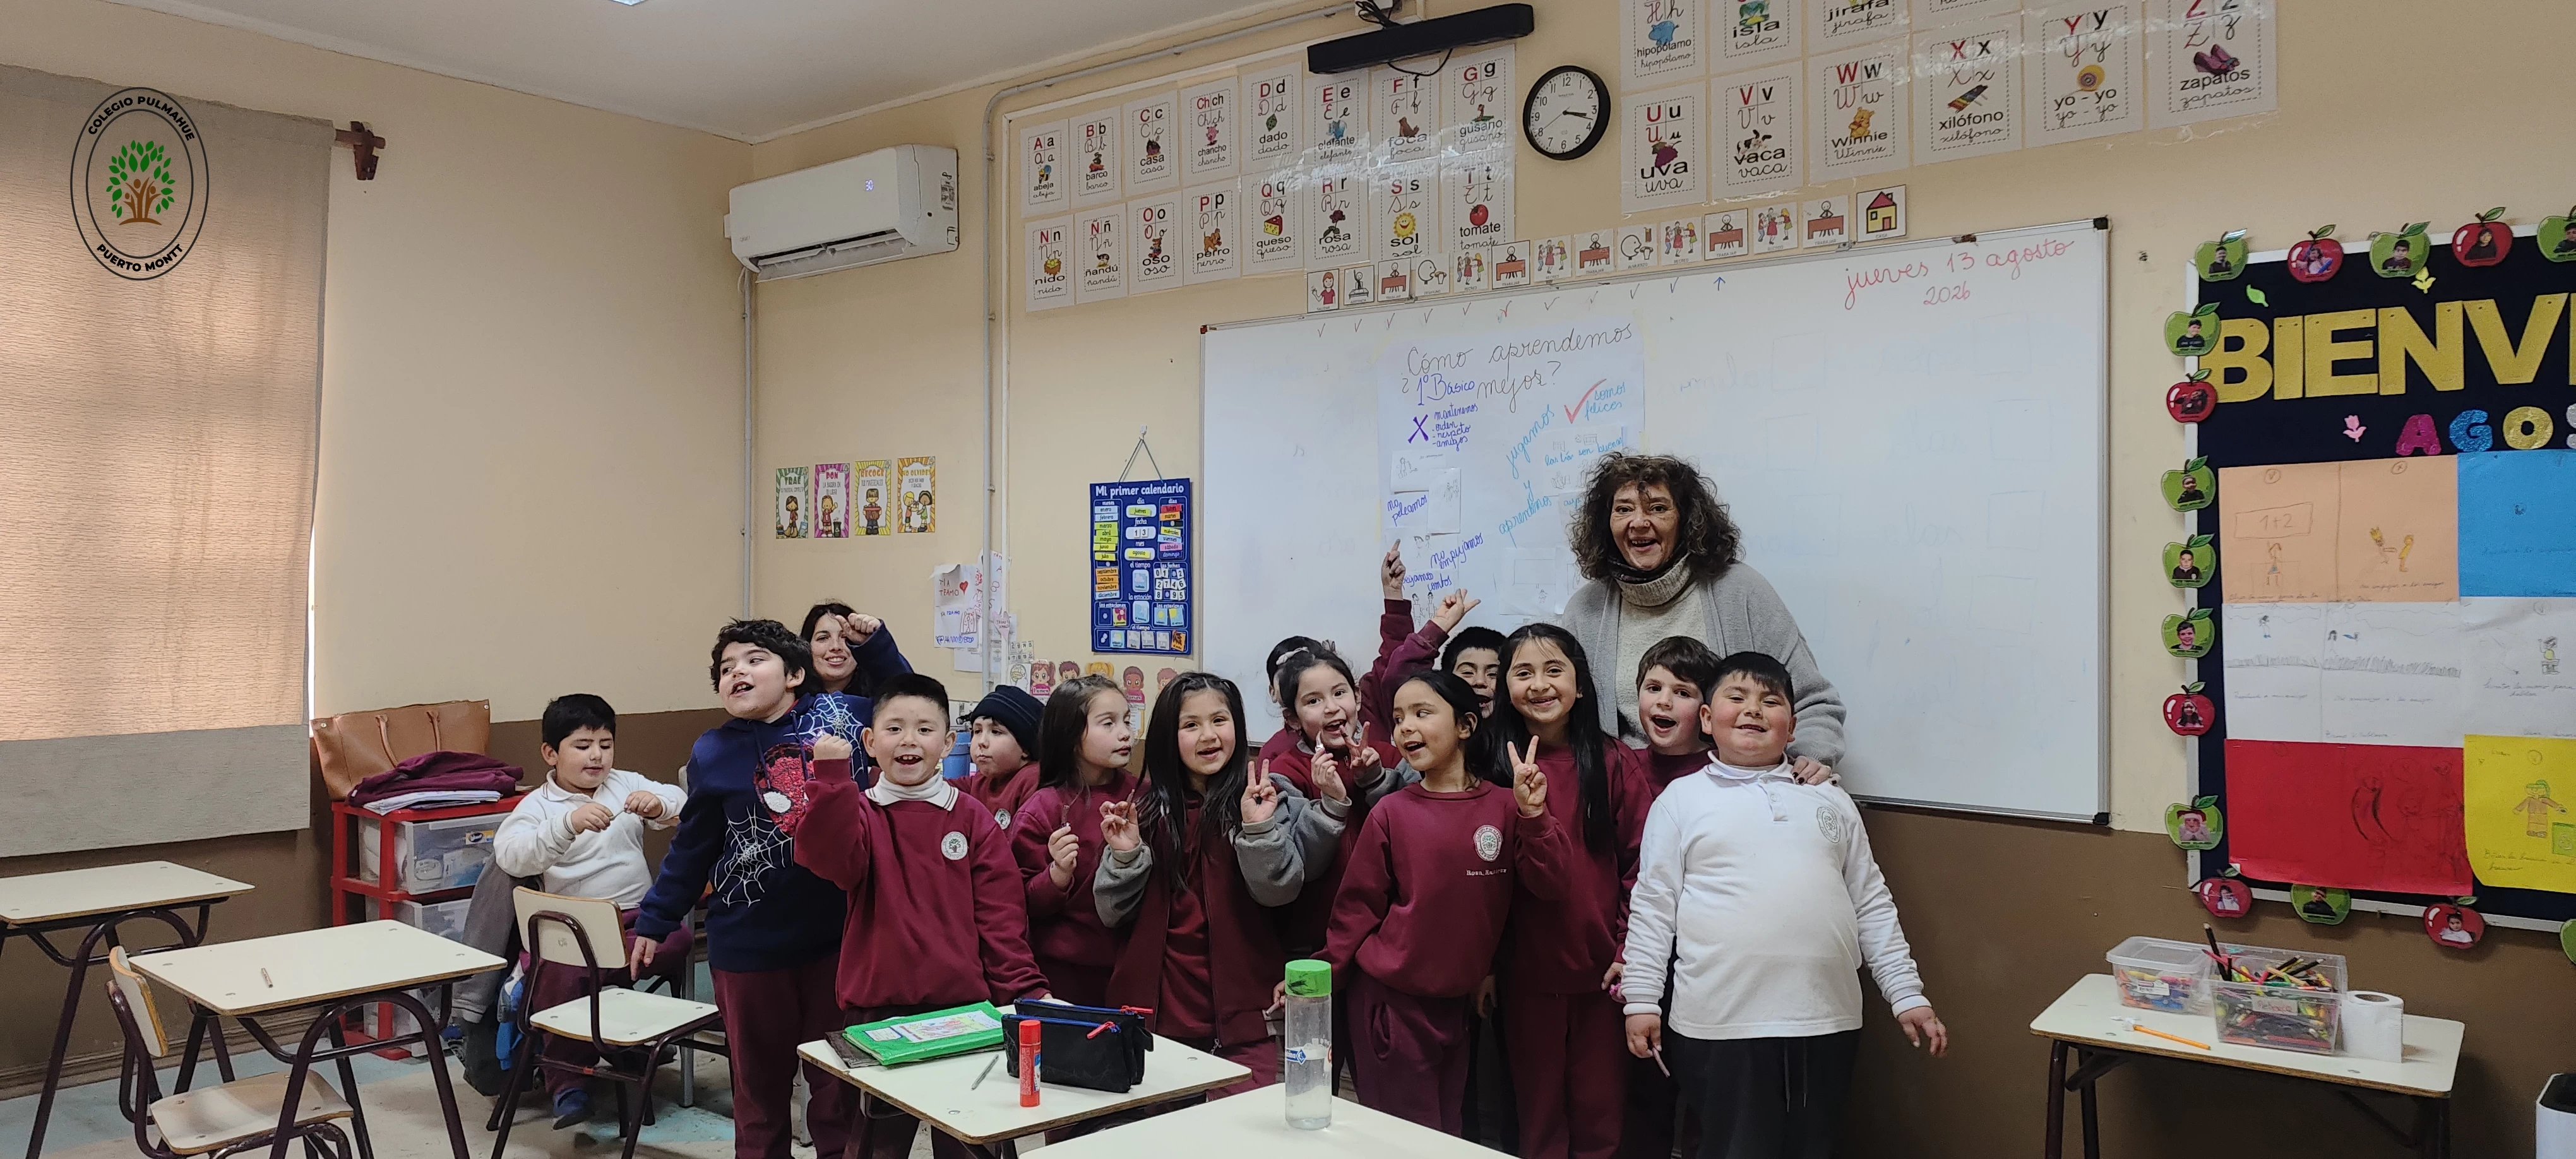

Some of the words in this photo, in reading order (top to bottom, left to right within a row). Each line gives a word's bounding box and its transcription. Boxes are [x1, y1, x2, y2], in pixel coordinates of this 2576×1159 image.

[1733, 20, 1780, 38] isla
[2065, 16, 2082, 36] Y
[2094, 10, 2109, 30] y
[1637, 39, 1691, 57] hipopótamo
[1951, 40, 1966, 61] X
[1977, 40, 1991, 56] x
[1464, 67, 1477, 81] G
[1484, 61, 1496, 77] g
[1837, 61, 1858, 84] W
[1864, 62, 1882, 79] w
[1393, 79, 1404, 93] F
[1414, 75, 1420, 88] f
[1562, 76, 1571, 86] 12
[1579, 80, 1582, 89] 1
[2179, 69, 2250, 91] zapatos
[1260, 83, 1271, 98] D
[1277, 79, 1285, 93] d
[1323, 87, 1333, 103] E
[1340, 86, 1351, 98] e
[1551, 83, 1556, 93] 11
[1587, 89, 1594, 99] 2
[1739, 85, 1753, 106] V
[1762, 86, 1773, 101] v
[1197, 98, 1210, 109] Ch
[1212, 94, 1224, 106] ch
[1539, 96, 1547, 106] 10
[2053, 94, 2076, 111] yo
[2094, 87, 2116, 107] yo
[1140, 109, 1150, 122] C
[1155, 109, 1163, 119] c
[1534, 112, 1540, 121] 9
[1592, 105, 1597, 114] 3
[1647, 105, 1662, 122] U
[1669, 104, 1681, 118] u
[1460, 119, 1503, 136] gusano
[1586, 122, 1591, 131] 4
[1939, 109, 2004, 132] xilófono
[1086, 126, 1094, 137] B
[1098, 122, 1106, 134] b
[1537, 128, 1544, 136] 8
[1034, 138, 1043, 150] A
[1047, 138, 1054, 147] a
[1260, 131, 1287, 144] dado
[1388, 133, 1428, 146] foca
[1547, 137, 1553, 147] 7
[1561, 140, 1566, 149] 6
[1575, 135, 1581, 144] 5
[1198, 145, 1226, 157] chancho
[1734, 148, 1786, 165] vaca
[1140, 155, 1164, 167] casa
[1086, 170, 1107, 181] barco
[1642, 161, 1688, 179] uva
[1261, 183, 1272, 198] Q
[1277, 181, 1285, 195] q
[1391, 179, 1402, 194] S
[1410, 179, 1420, 191] s
[1200, 197, 1209, 211] P
[1215, 194, 1224, 208] p
[1091, 220, 1099, 235] Ñ
[1104, 221, 1111, 232] ñ
[1460, 223, 1501, 237] tomate
[1041, 230, 1049, 242] N
[1053, 230, 1061, 241] n
[1256, 235, 1292, 249] queso
[1319, 232, 1351, 246] rosa
[1390, 234, 1419, 247] sol
[1142, 255, 1170, 266] oso
[1197, 248, 1229, 260] perro
[1085, 264, 1118, 276] ñandú
[1844, 261, 1929, 310] jueves
[1947, 252, 1975, 273] 13
[1986, 239, 2075, 281] agosto
[1035, 275, 1065, 285] nido
[1923, 281, 1970, 305] 2026
[1407, 347, 1474, 376] Cómo
[1488, 323, 1632, 380] aprendemos
[2199, 293, 2576, 403] BIENV
[1594, 382, 1626, 401] somos
[1585, 400, 1622, 421] felices
[1506, 404, 1554, 479] jugamos
[1095, 485, 1107, 496] Mi
[1110, 487, 1139, 499] primer
[1141, 483, 1184, 496] calendario
